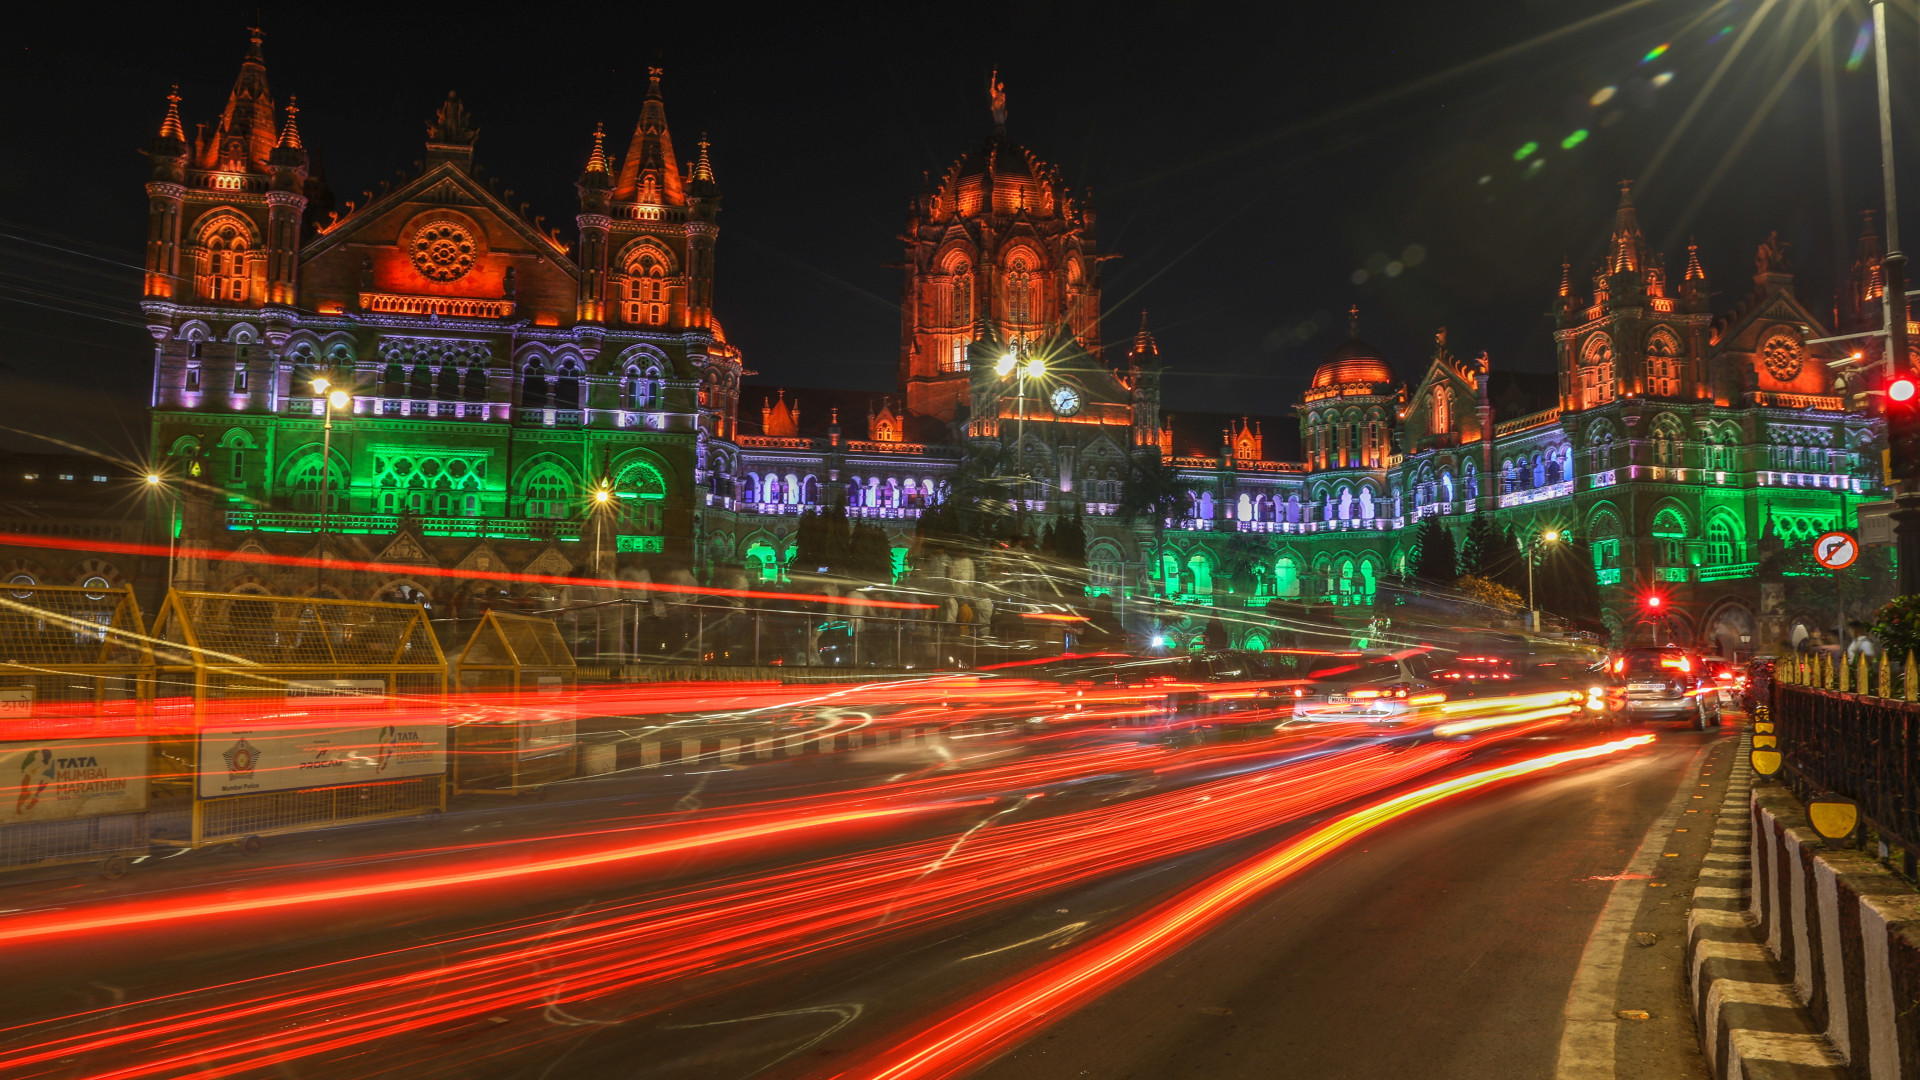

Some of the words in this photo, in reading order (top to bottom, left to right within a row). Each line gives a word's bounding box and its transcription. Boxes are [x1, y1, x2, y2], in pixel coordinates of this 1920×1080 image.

[397, 731, 419, 741] TATA
[57, 756, 98, 769] TATA
[299, 760, 343, 770] PROCAM
[56, 768, 107, 782] MUMBAI
[56, 778, 127, 796] MARATHON
